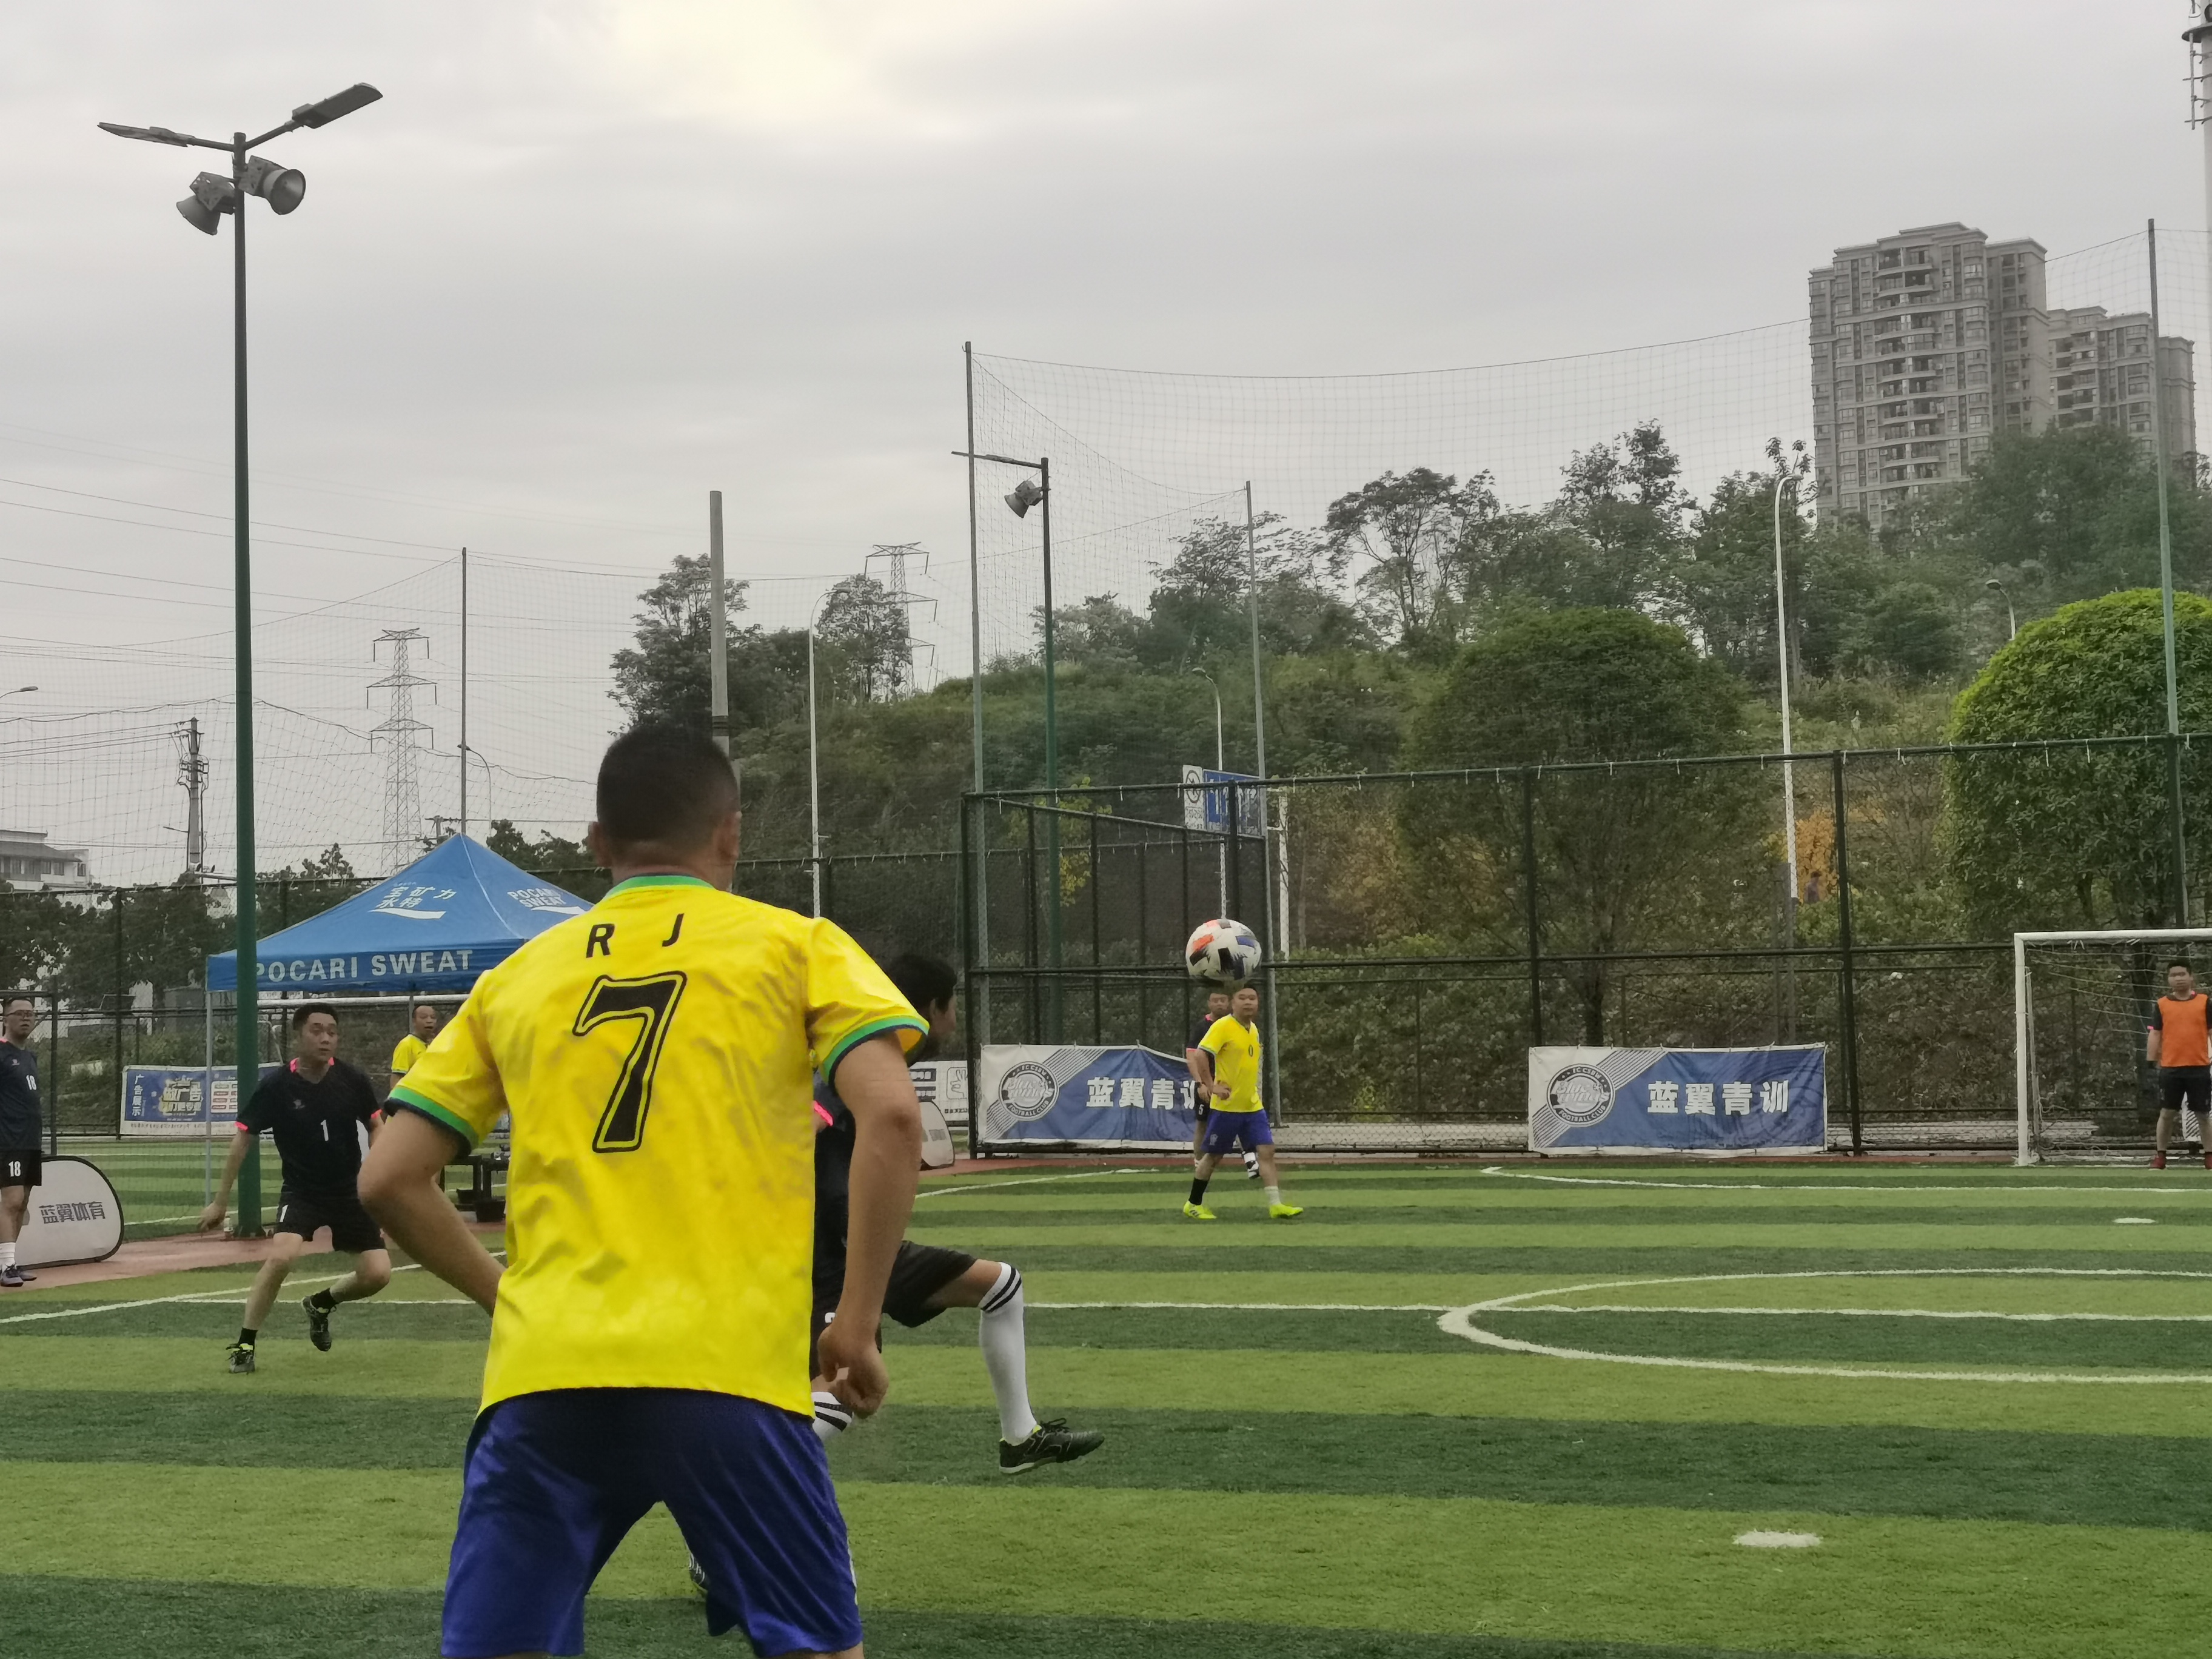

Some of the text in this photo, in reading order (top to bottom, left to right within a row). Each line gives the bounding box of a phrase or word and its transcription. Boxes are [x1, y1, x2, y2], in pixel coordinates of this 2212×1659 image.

[376, 897, 423, 908] 水特
[384, 886, 457, 900] 宝矿力
[519, 896, 566, 907] SWEAT
[586, 913, 685, 958] R J
[371, 950, 473, 976] SWEAT
[572, 970, 688, 1153] 7
[26, 1075, 37, 1090] 18
[132, 1074, 145, 1116] 广告展示
[1647, 1080, 1789, 1115] 蓝翼青训
[1558, 1105, 1606, 1122] FOOTBALL CLUB
[320, 1119, 329, 1142] 1
[8, 1161, 21, 1177] 18
[39, 1201, 106, 1224] 蓝翼体育
